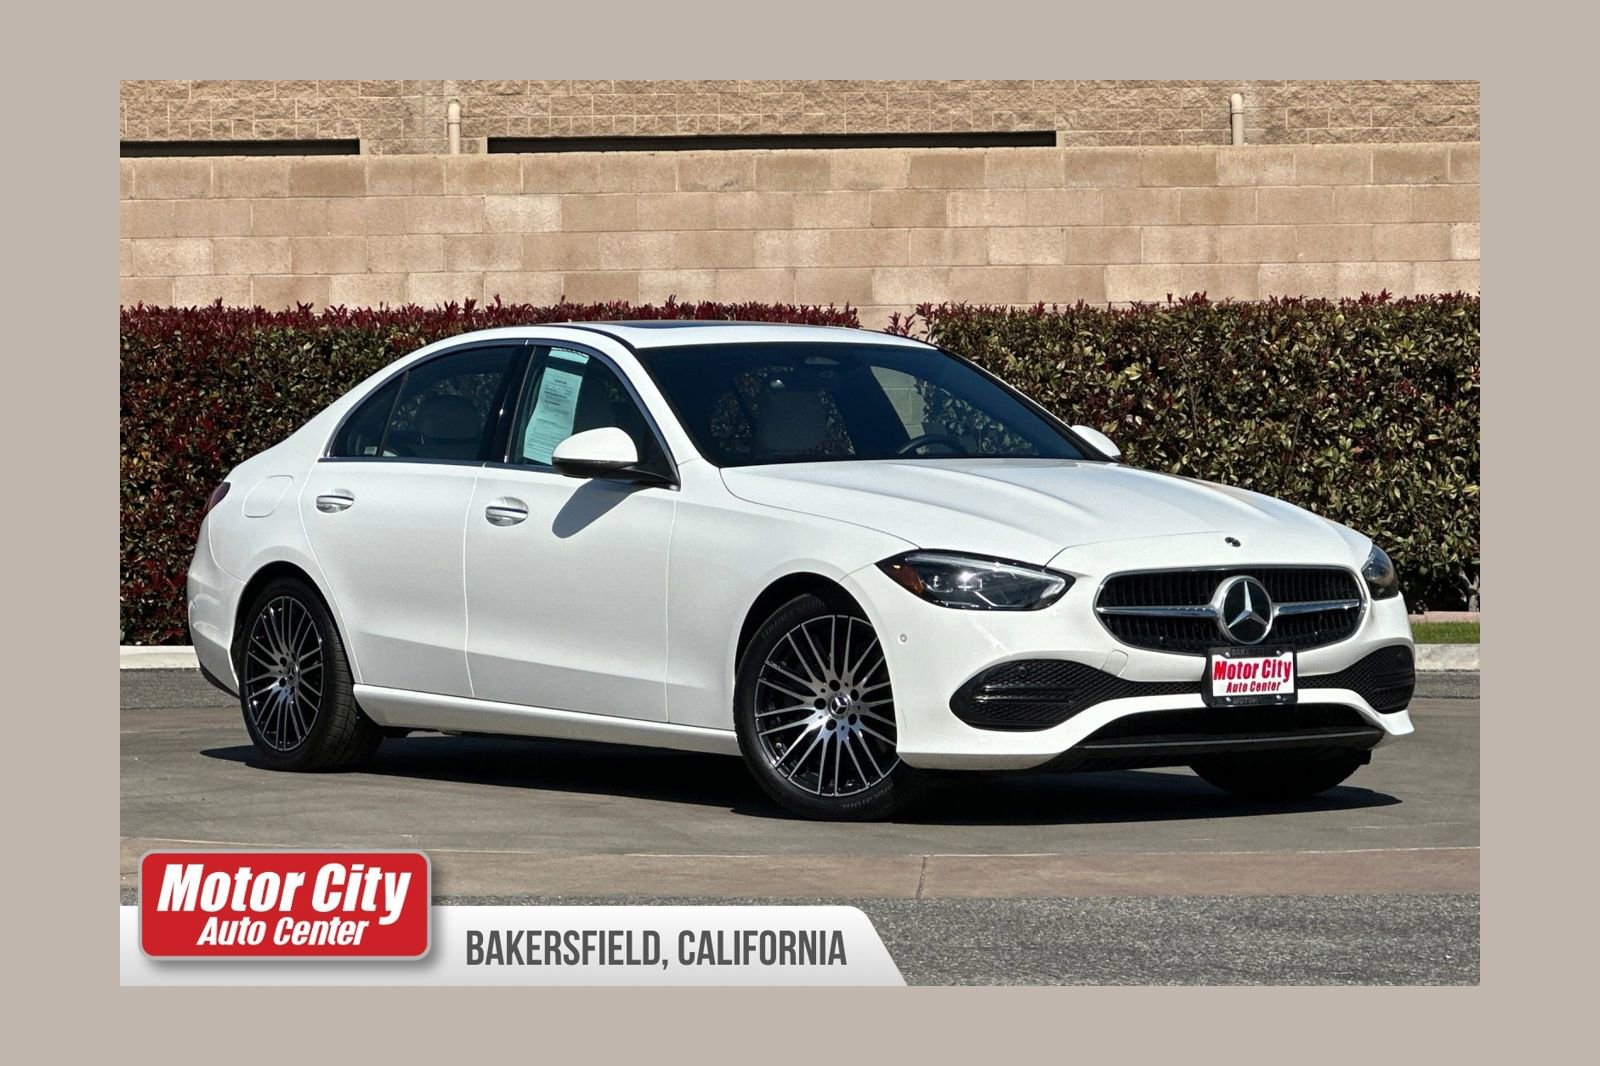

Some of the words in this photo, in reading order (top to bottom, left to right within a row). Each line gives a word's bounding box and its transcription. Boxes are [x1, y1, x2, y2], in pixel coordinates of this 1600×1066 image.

[1213, 660, 1260, 681] Motor
[1261, 658, 1292, 683] City
[1226, 681, 1248, 693] Auto
[1249, 680, 1281, 692] Center
